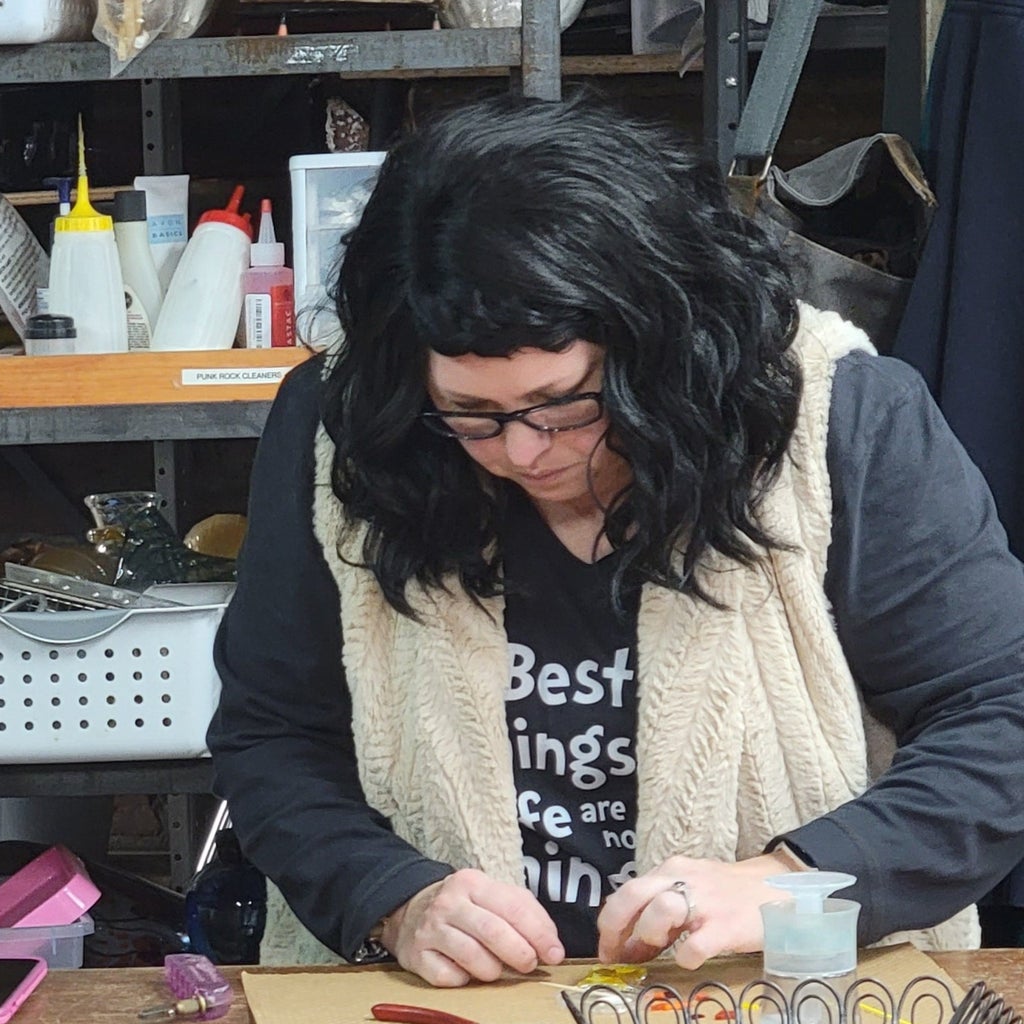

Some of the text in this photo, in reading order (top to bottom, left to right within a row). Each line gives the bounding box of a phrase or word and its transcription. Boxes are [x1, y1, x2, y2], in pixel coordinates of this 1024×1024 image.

[242, 371, 282, 379] CLEANERS
[505, 642, 635, 707] Best
[513, 717, 636, 790] ings
[518, 790, 626, 838] fe are
[602, 829, 637, 850] no
